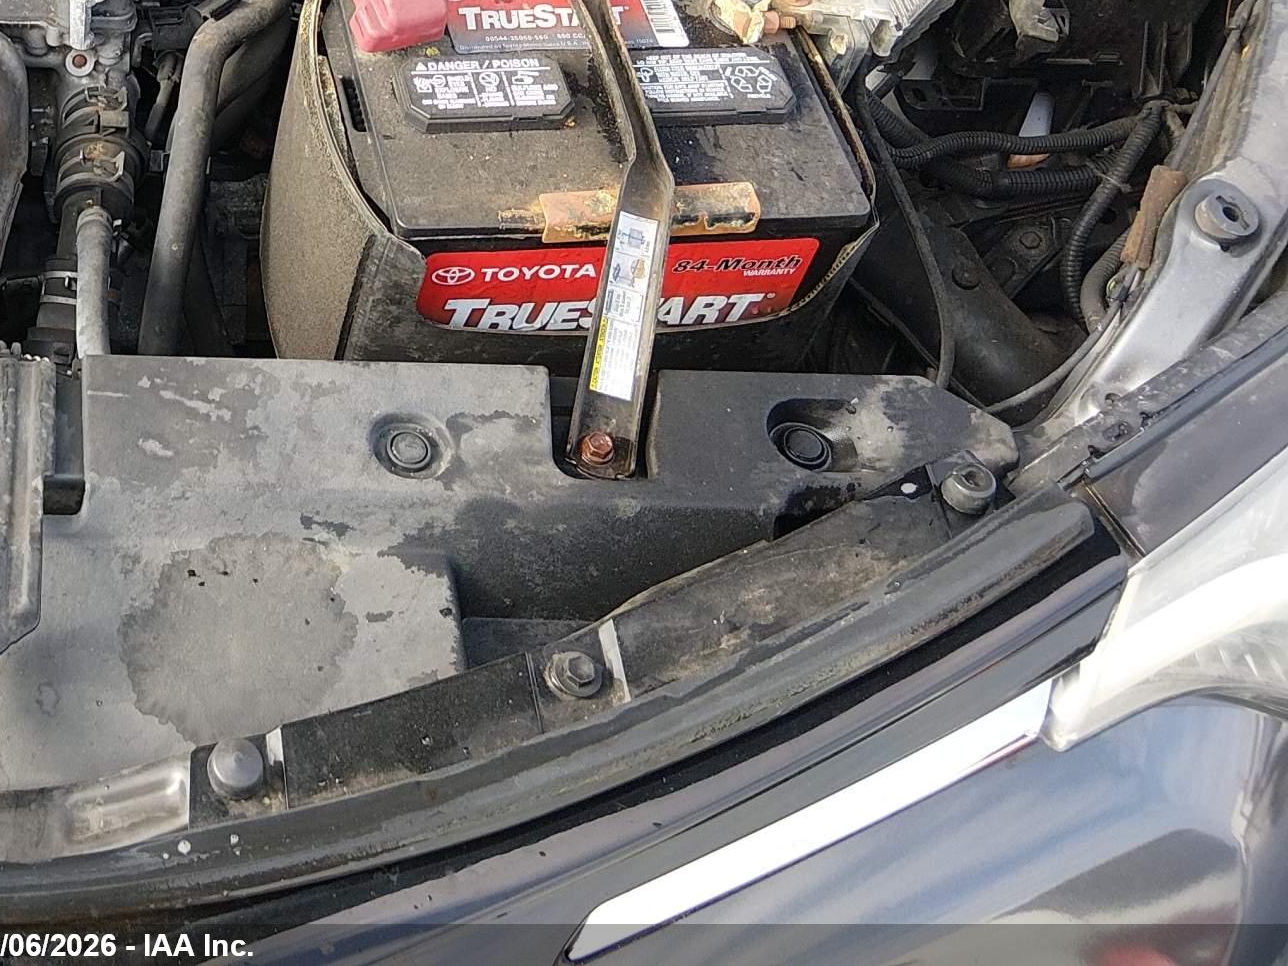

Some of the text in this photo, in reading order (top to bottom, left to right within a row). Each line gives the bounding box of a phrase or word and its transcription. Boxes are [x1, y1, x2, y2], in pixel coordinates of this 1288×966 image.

[427, 58, 540, 72] DANGER / POISON
[672, 254, 803, 273] 84-Month
[481, 263, 597, 283] TOYOTA
[743, 268, 797, 277] WARRANTY
